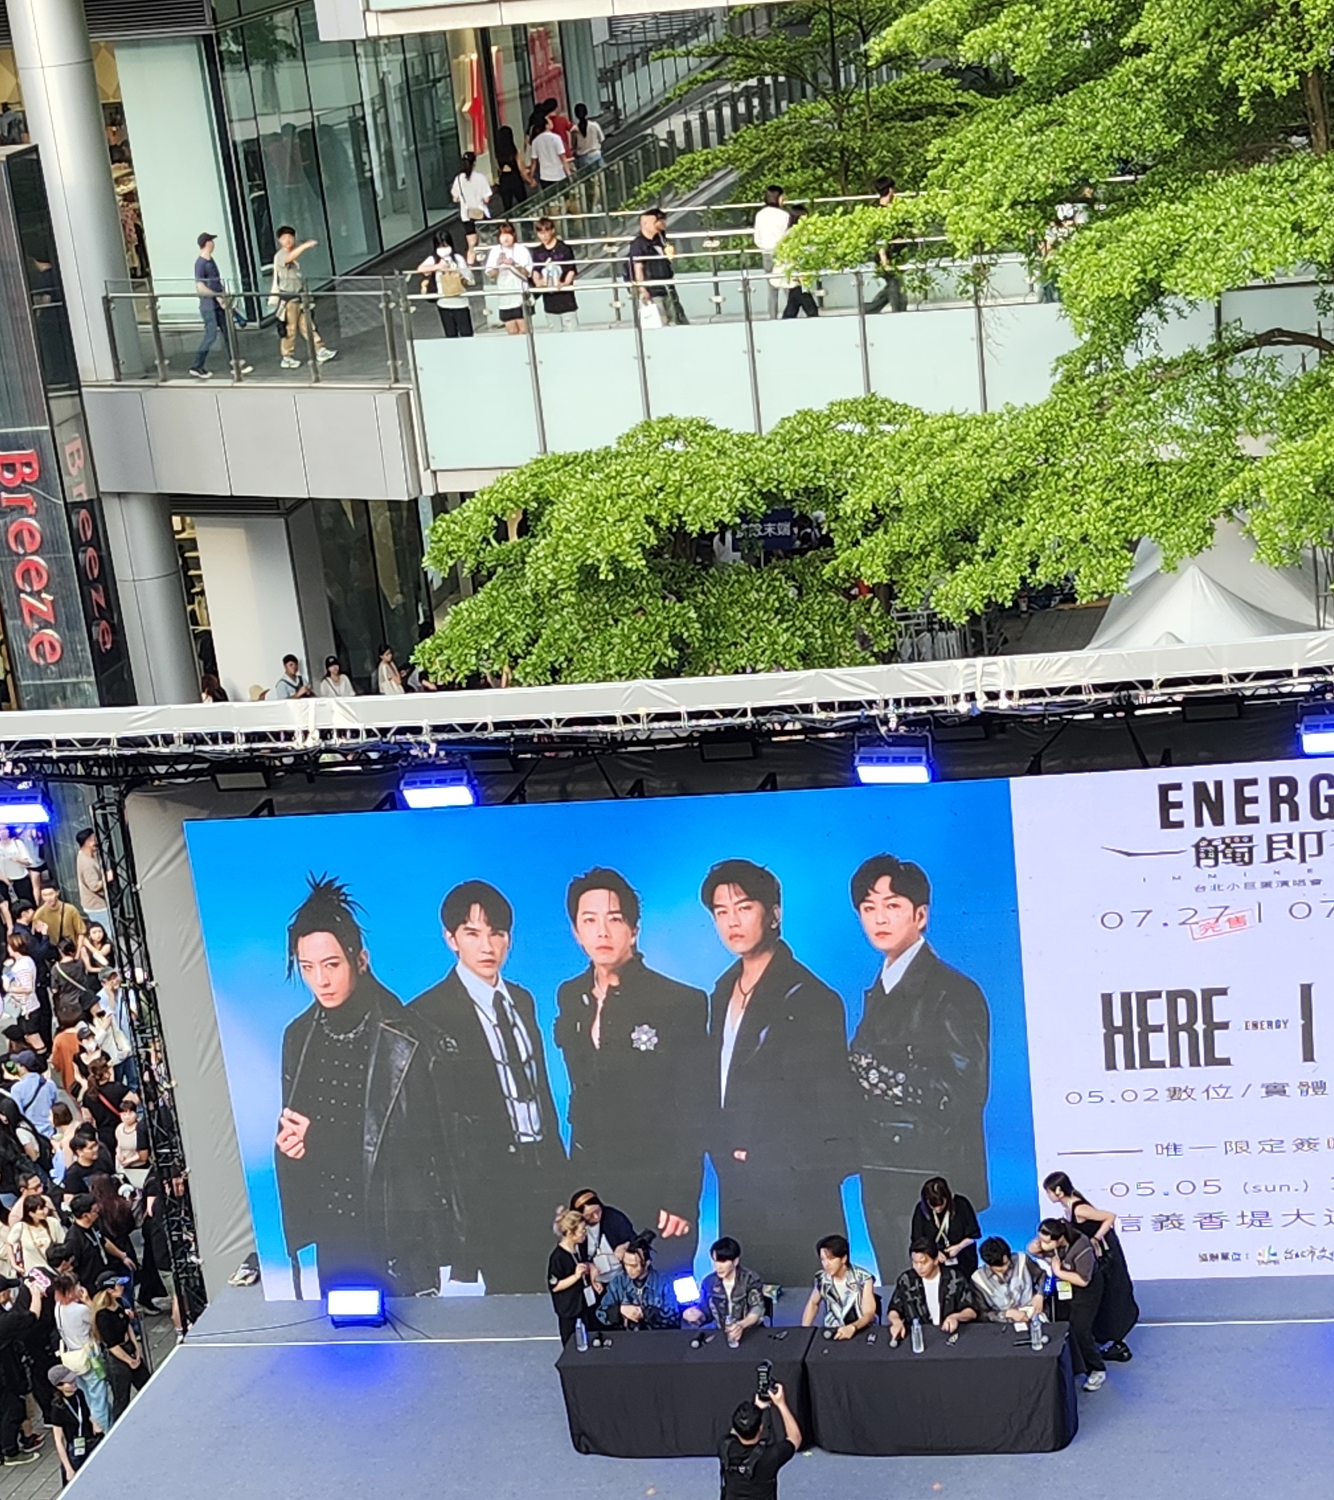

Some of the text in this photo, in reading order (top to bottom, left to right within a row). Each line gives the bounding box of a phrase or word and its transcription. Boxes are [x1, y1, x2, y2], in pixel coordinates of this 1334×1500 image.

[1101, 904, 1230, 930] 07.27
[1100, 986, 1233, 1072] HERE
[1299, 982, 1317, 1063] I
[1244, 1018, 1290, 1031] ENERGY
[1109, 1178, 1223, 1198] 05.05
[1243, 1179, 1310, 1195] (sun.)
